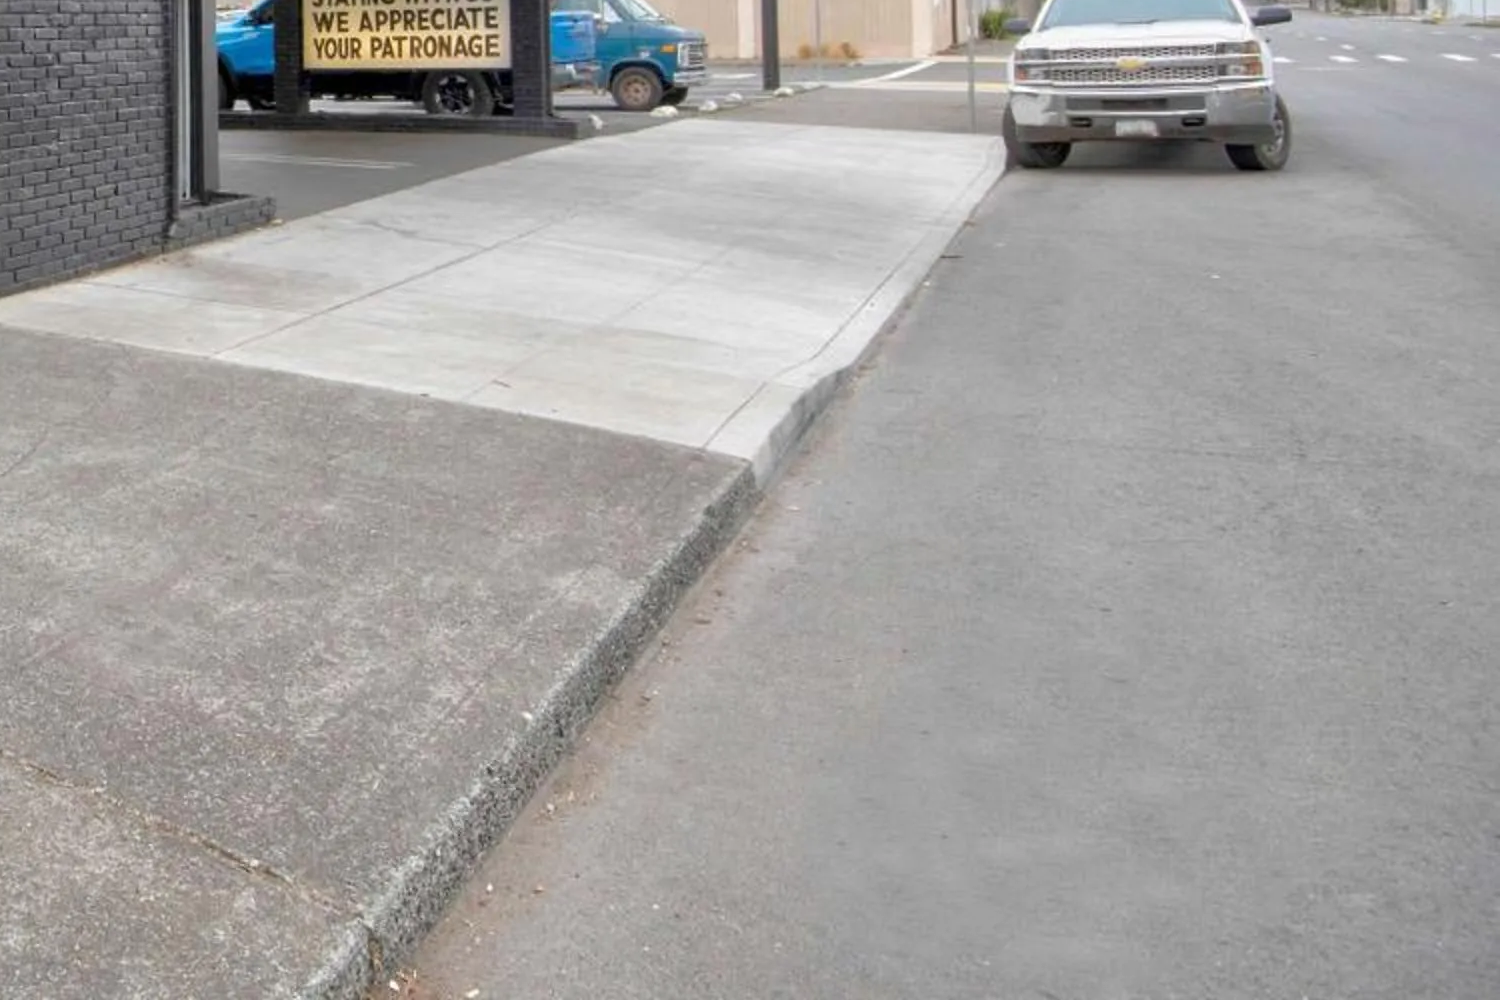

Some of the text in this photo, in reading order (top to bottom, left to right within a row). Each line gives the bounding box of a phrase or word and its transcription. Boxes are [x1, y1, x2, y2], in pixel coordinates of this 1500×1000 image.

[312, 6, 499, 32] WE APPRECIATE
[313, 34, 500, 60] YOUR PATRONAGE
